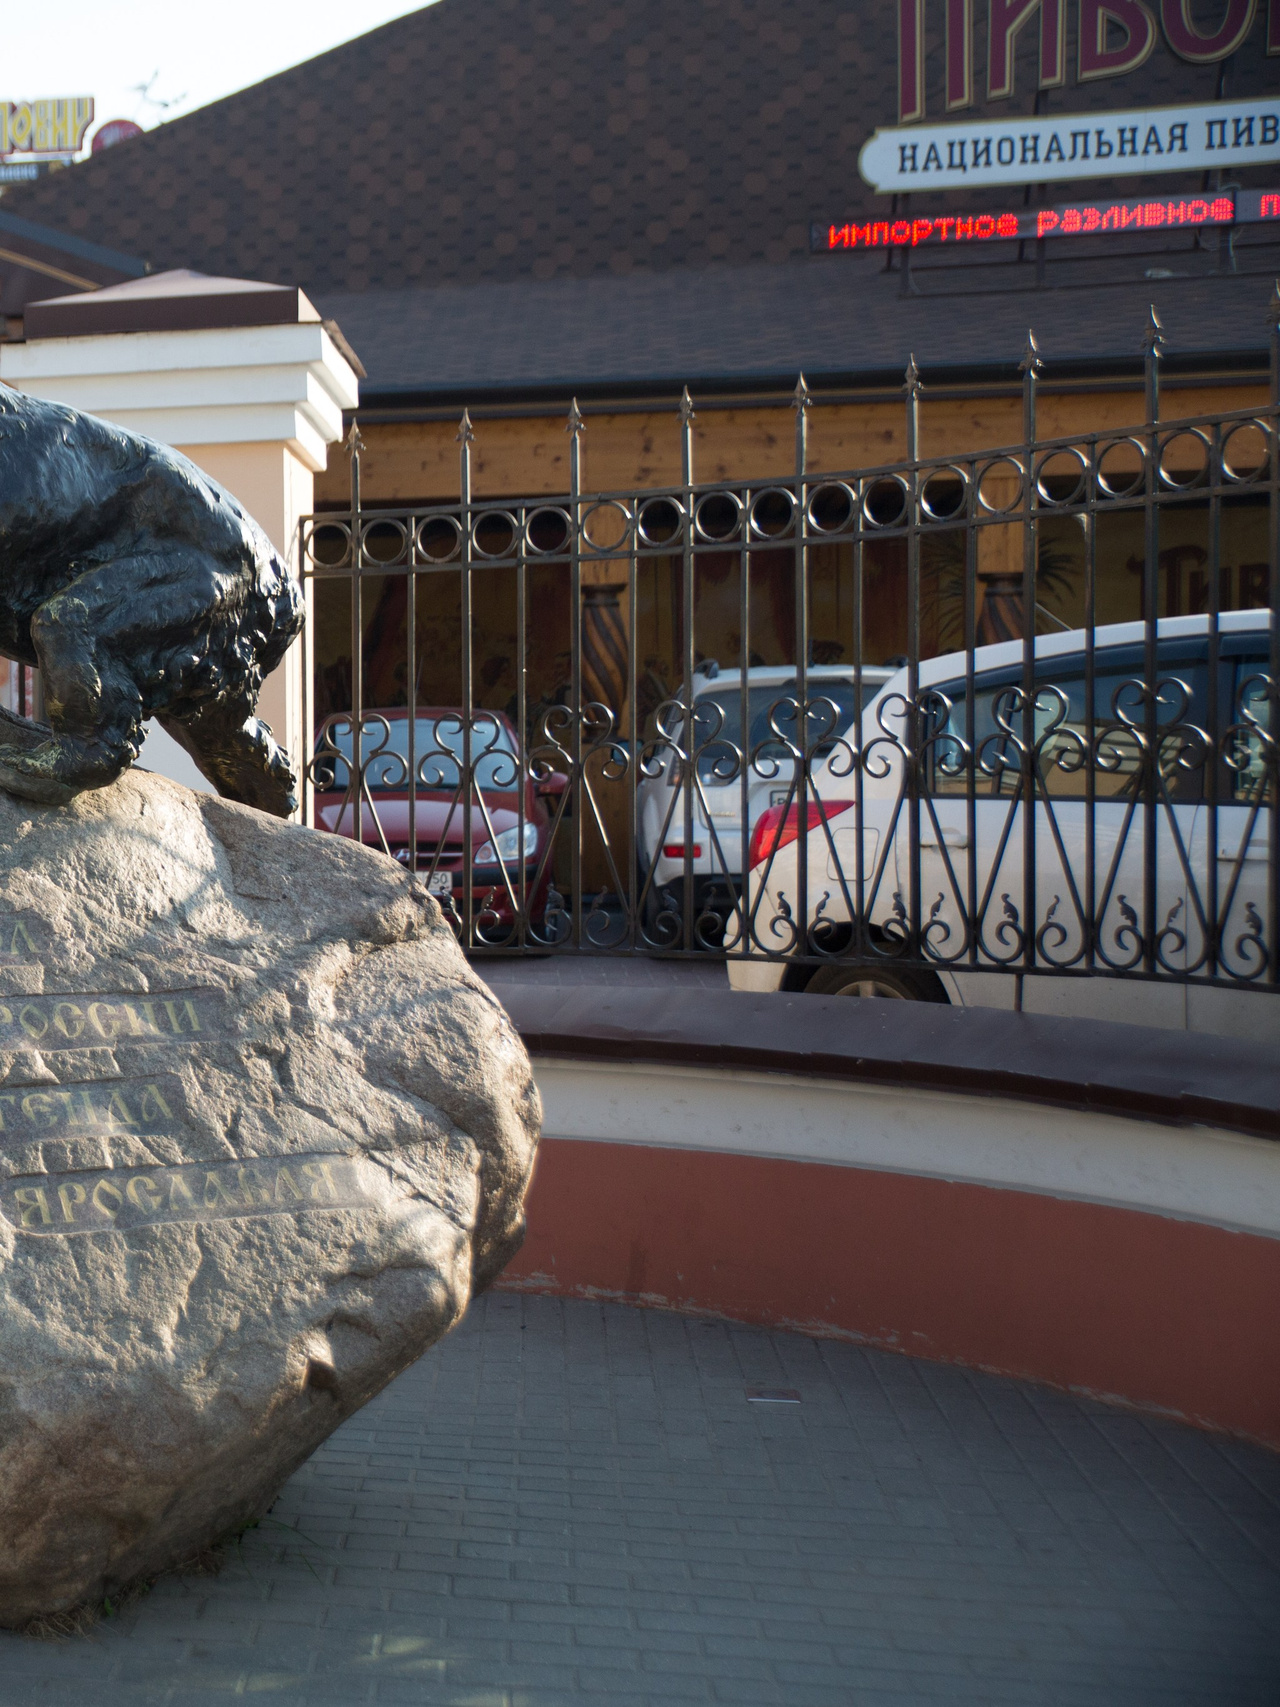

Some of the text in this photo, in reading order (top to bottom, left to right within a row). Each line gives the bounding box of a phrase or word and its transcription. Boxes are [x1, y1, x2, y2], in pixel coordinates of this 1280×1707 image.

[898, 0, 1280, 127] ПИВО
[898, 122, 1188, 174] НАЦИОНАЛЬНАЯ
[14, 1162, 338, 1228] ЯРОСЛАВЛЯ
